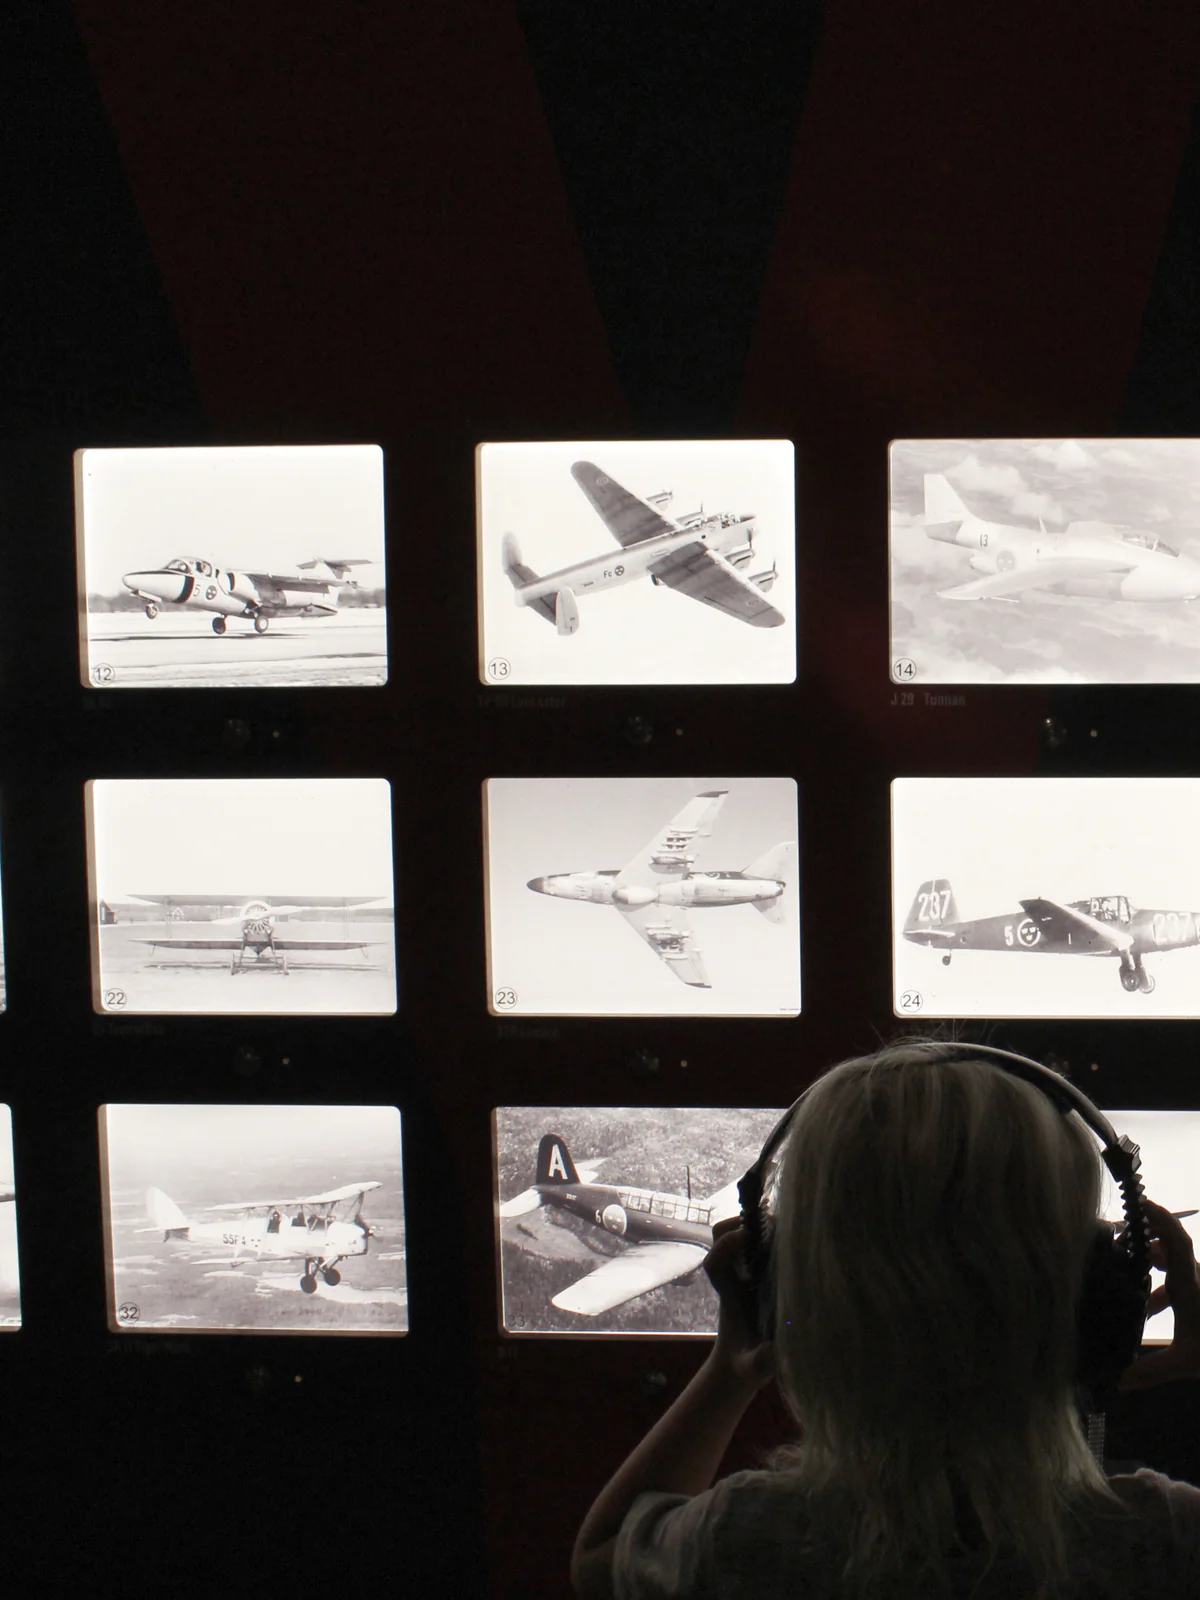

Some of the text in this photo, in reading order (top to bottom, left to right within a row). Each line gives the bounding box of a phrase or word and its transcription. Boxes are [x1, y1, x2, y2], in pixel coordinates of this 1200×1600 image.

[979, 534, 988, 548] 13
[192, 584, 201, 597] 5
[96, 667, 112, 681] 12
[491, 662, 509, 676] 13
[895, 662, 913, 677] 14
[890, 692, 966, 706] J 29 Tunnan
[1152, 911, 1192, 946] 237
[1003, 925, 1014, 947] 5
[107, 991, 125, 1005] 22
[497, 991, 515, 1005] 23
[902, 994, 920, 1008] 24
[547, 1143, 569, 1180] A
[595, 1209, 602, 1224] 6
[120, 1306, 138, 1319] 32
[507, 1314, 525, 1328] 33
